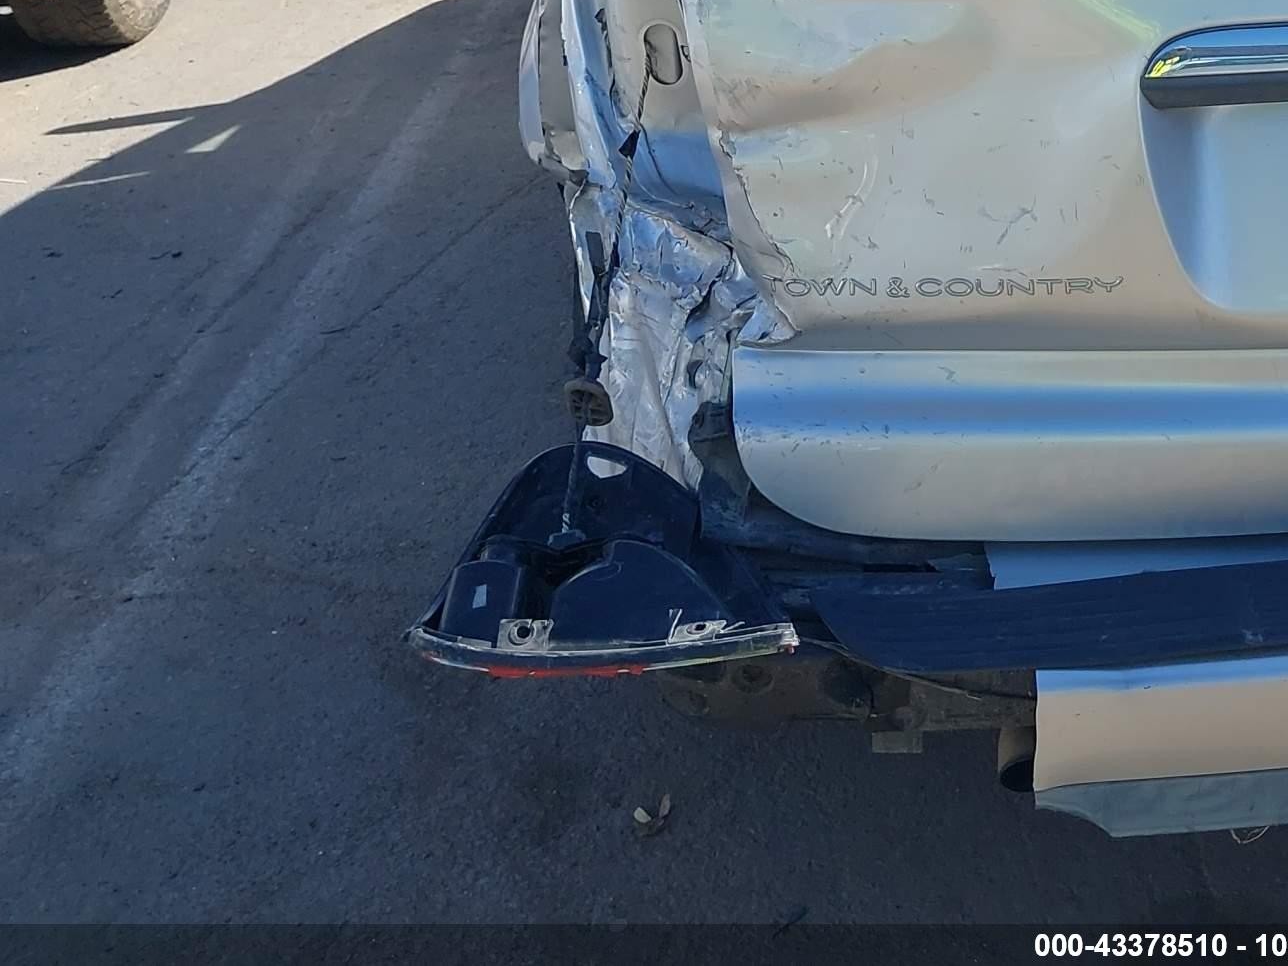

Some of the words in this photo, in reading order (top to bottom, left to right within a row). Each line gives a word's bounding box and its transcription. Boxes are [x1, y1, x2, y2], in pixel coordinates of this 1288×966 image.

[763, 274, 877, 298] TOWN
[885, 276, 911, 299] &
[914, 275, 1124, 298] COUNTRY
